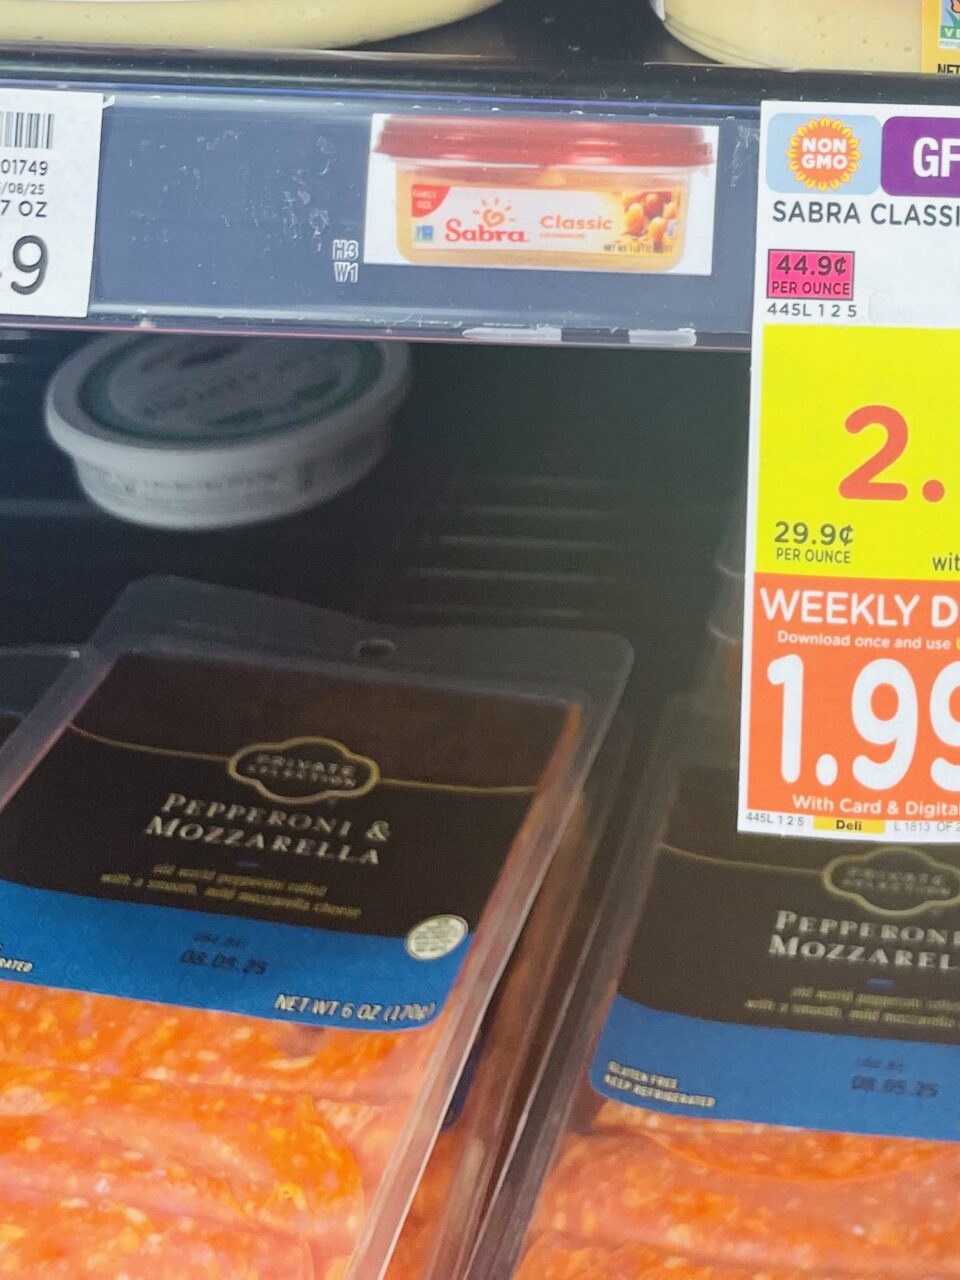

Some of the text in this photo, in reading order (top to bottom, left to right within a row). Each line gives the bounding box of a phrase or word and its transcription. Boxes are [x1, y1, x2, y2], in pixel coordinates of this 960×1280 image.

[802, 138, 847, 153] NON
[802, 155, 848, 169] GMO
[19, 200, 47, 218] OZ
[773, 200, 861, 224] SABRA
[445, 218, 526, 242] Sabra
[539, 215, 613, 231] Classic
[775, 255, 847, 277] 44.9¢
[771, 280, 850, 296] PER OUNCE
[767, 302, 812, 317] 445L
[774, 521, 854, 546] 29.9¢
[776, 548, 851, 564] PER OUNCE
[760, 587, 920, 626] WEEKLY
[777, 630, 850, 647] Download
[854, 635, 890, 648] once
[894, 636, 922, 649] and
[926, 638, 951, 650] use
[792, 794, 834, 812] With
[839, 797, 882, 815] Card
[746, 812, 773, 824] 445L
[836, 819, 862, 831] Deli
